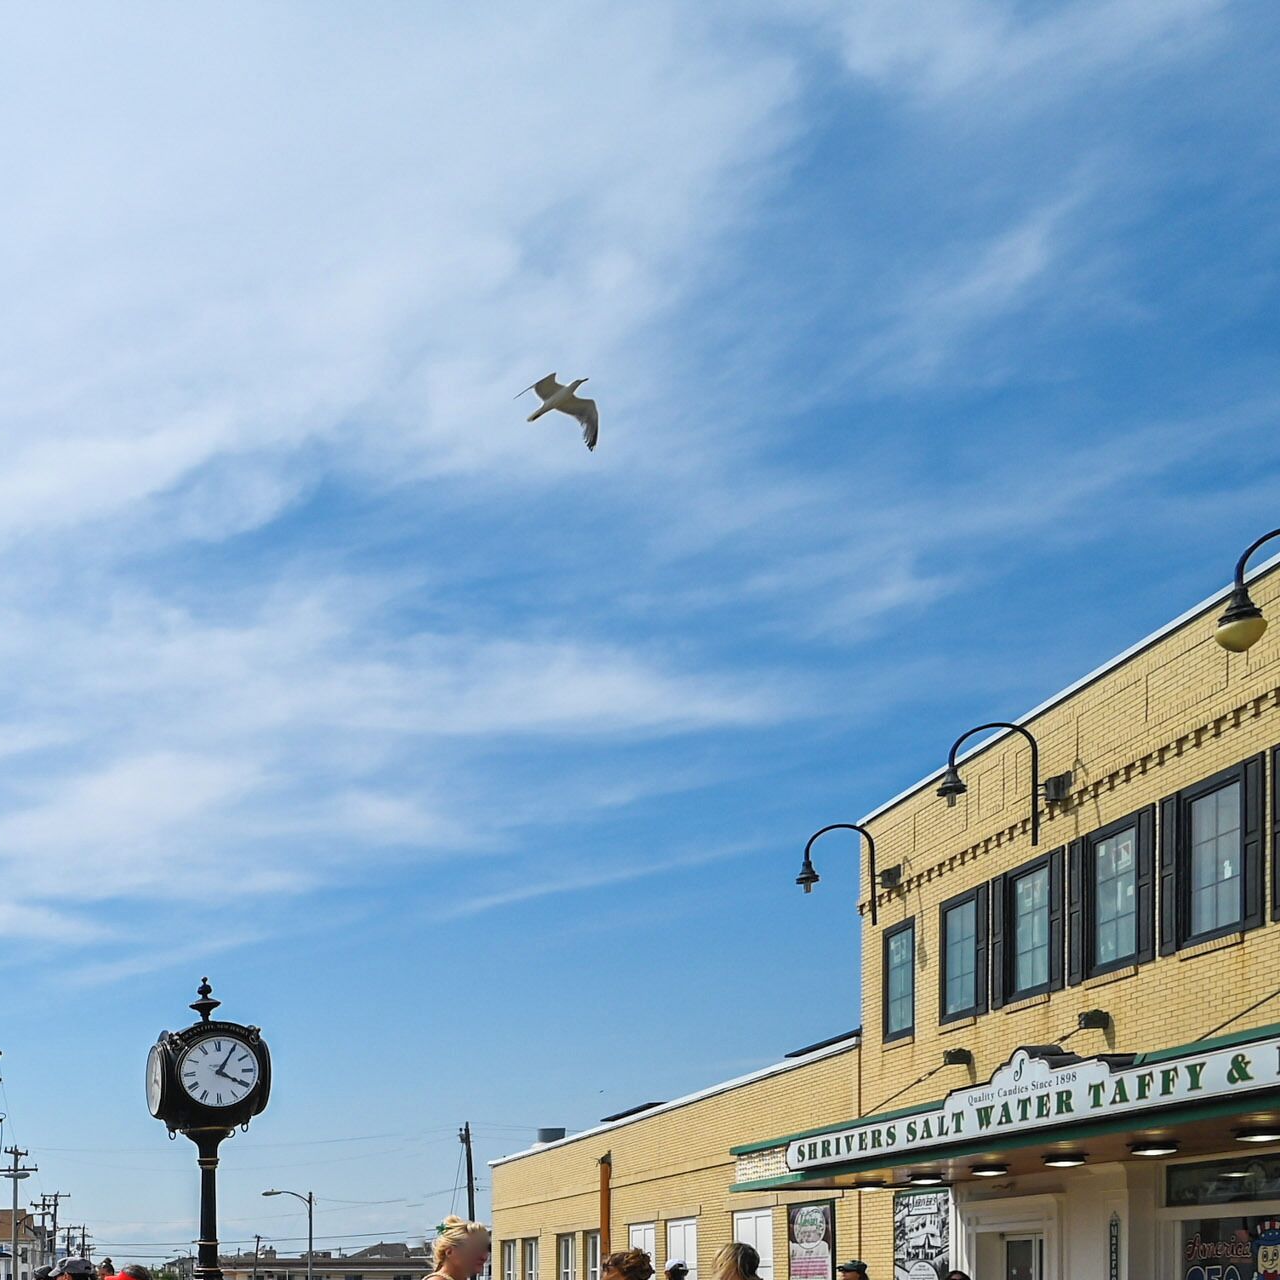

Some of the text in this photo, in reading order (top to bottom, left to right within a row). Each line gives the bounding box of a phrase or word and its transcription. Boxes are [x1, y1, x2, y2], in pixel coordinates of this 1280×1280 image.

[967, 1071, 1077, 1106] Quality Candies Since 1898
[797, 1124, 896, 1163] SHRIVERS
[906, 1110, 964, 1143] SALT
[976, 1089, 1074, 1131] WATER
[1088, 1061, 1206, 1109] TAFFY
[1227, 1054, 1253, 1085] &
[1185, 1232, 1252, 1260] America
